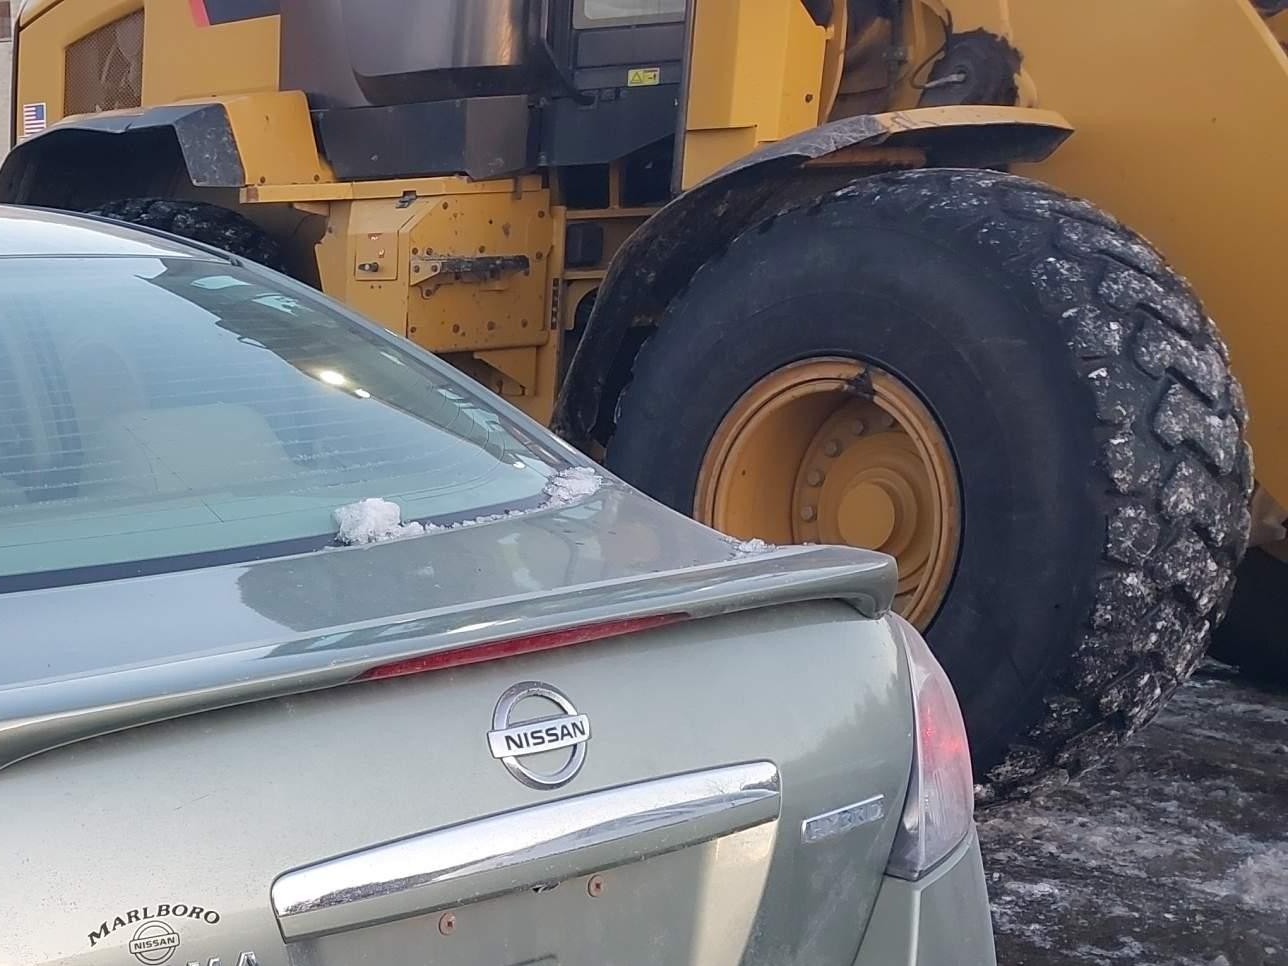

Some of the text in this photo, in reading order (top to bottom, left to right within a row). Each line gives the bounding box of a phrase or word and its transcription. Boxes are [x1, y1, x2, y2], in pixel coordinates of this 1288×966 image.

[504, 720, 586, 751] NISSAN
[87, 904, 220, 947] MARLBORO
[133, 936, 176, 950] NISSAN
